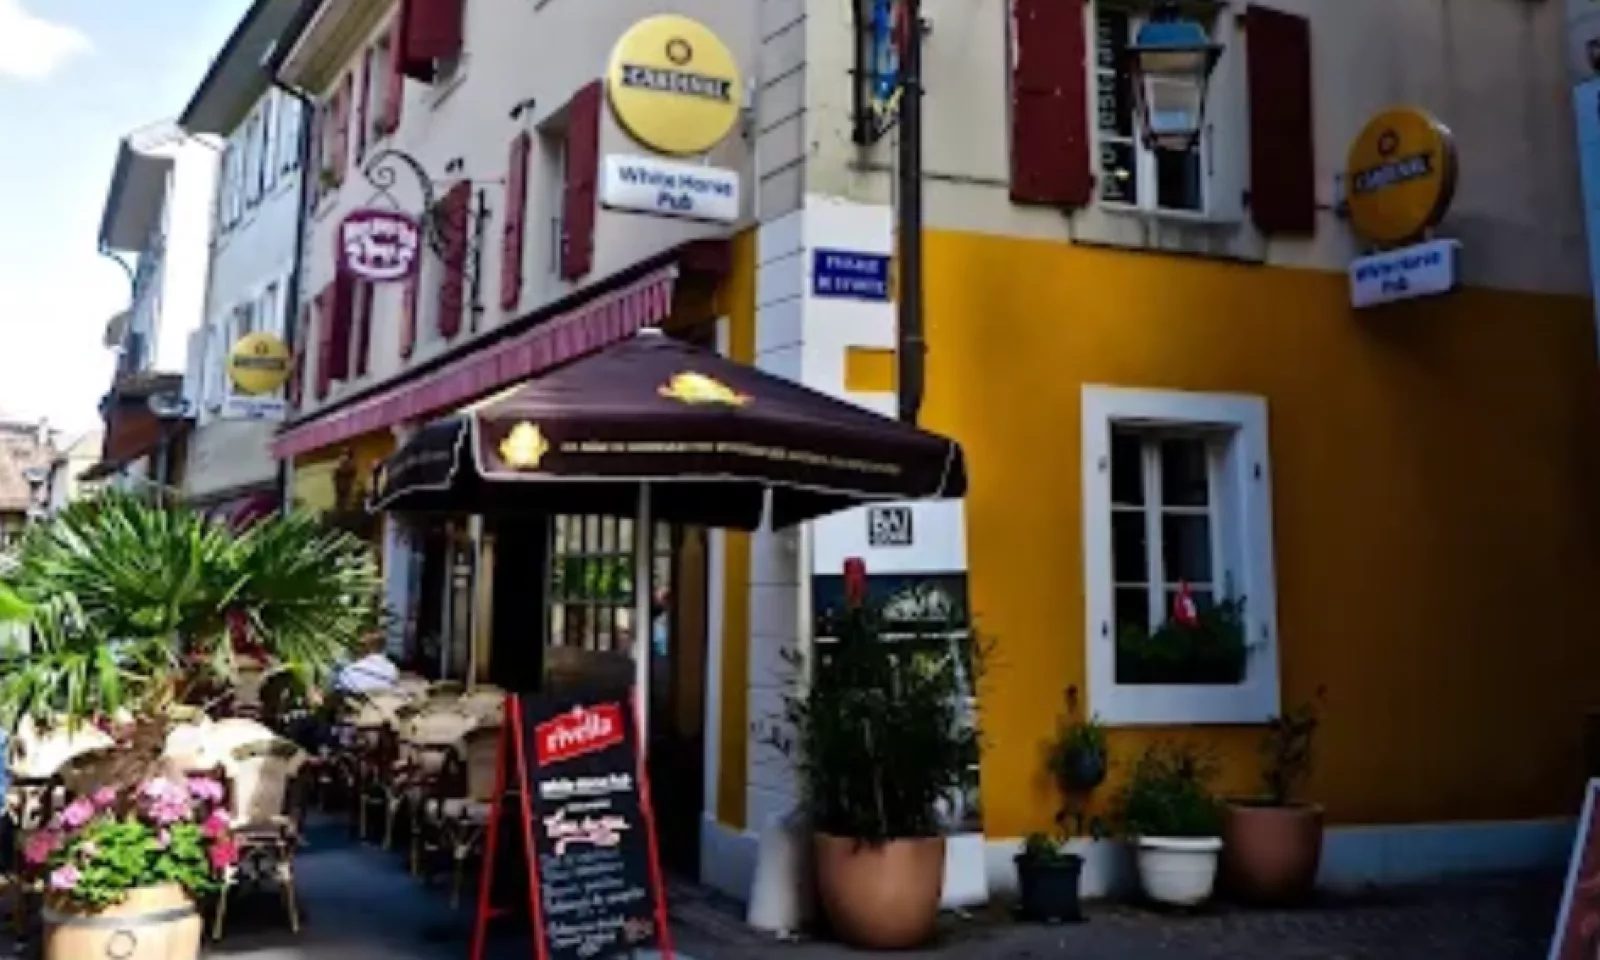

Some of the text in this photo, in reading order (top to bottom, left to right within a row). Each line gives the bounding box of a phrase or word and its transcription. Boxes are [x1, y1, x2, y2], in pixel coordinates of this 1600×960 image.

[619, 166, 733, 197] White Horse
[656, 191, 694, 211] Pub
[545, 714, 613, 753] rivella
